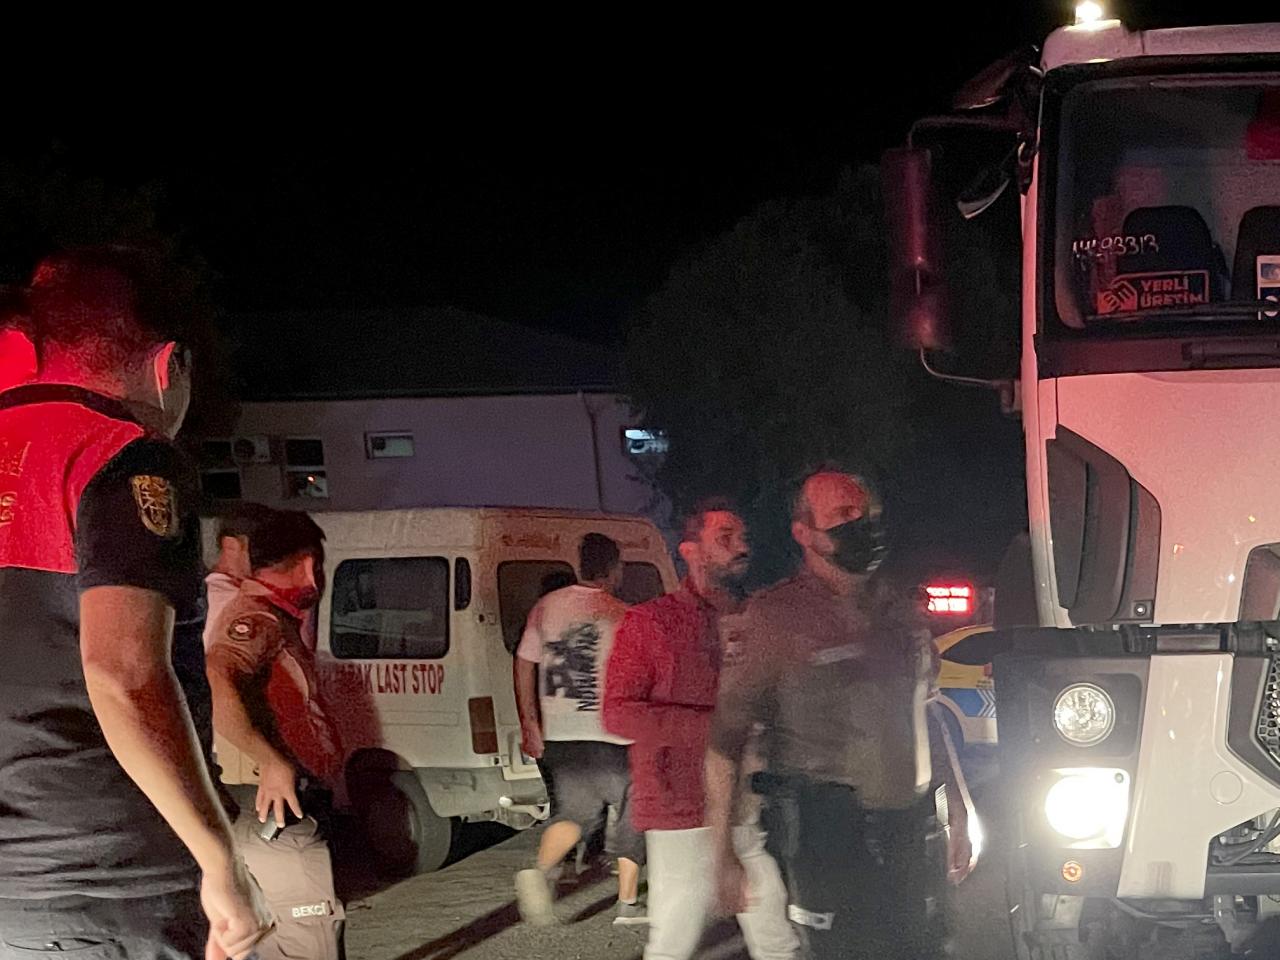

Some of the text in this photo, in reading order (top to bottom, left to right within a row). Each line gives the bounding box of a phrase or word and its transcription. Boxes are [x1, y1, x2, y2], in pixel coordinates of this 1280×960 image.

[1141, 275, 1189, 291] YERLİ
[377, 663, 407, 694] LAST
[412, 663, 444, 694] STOP
